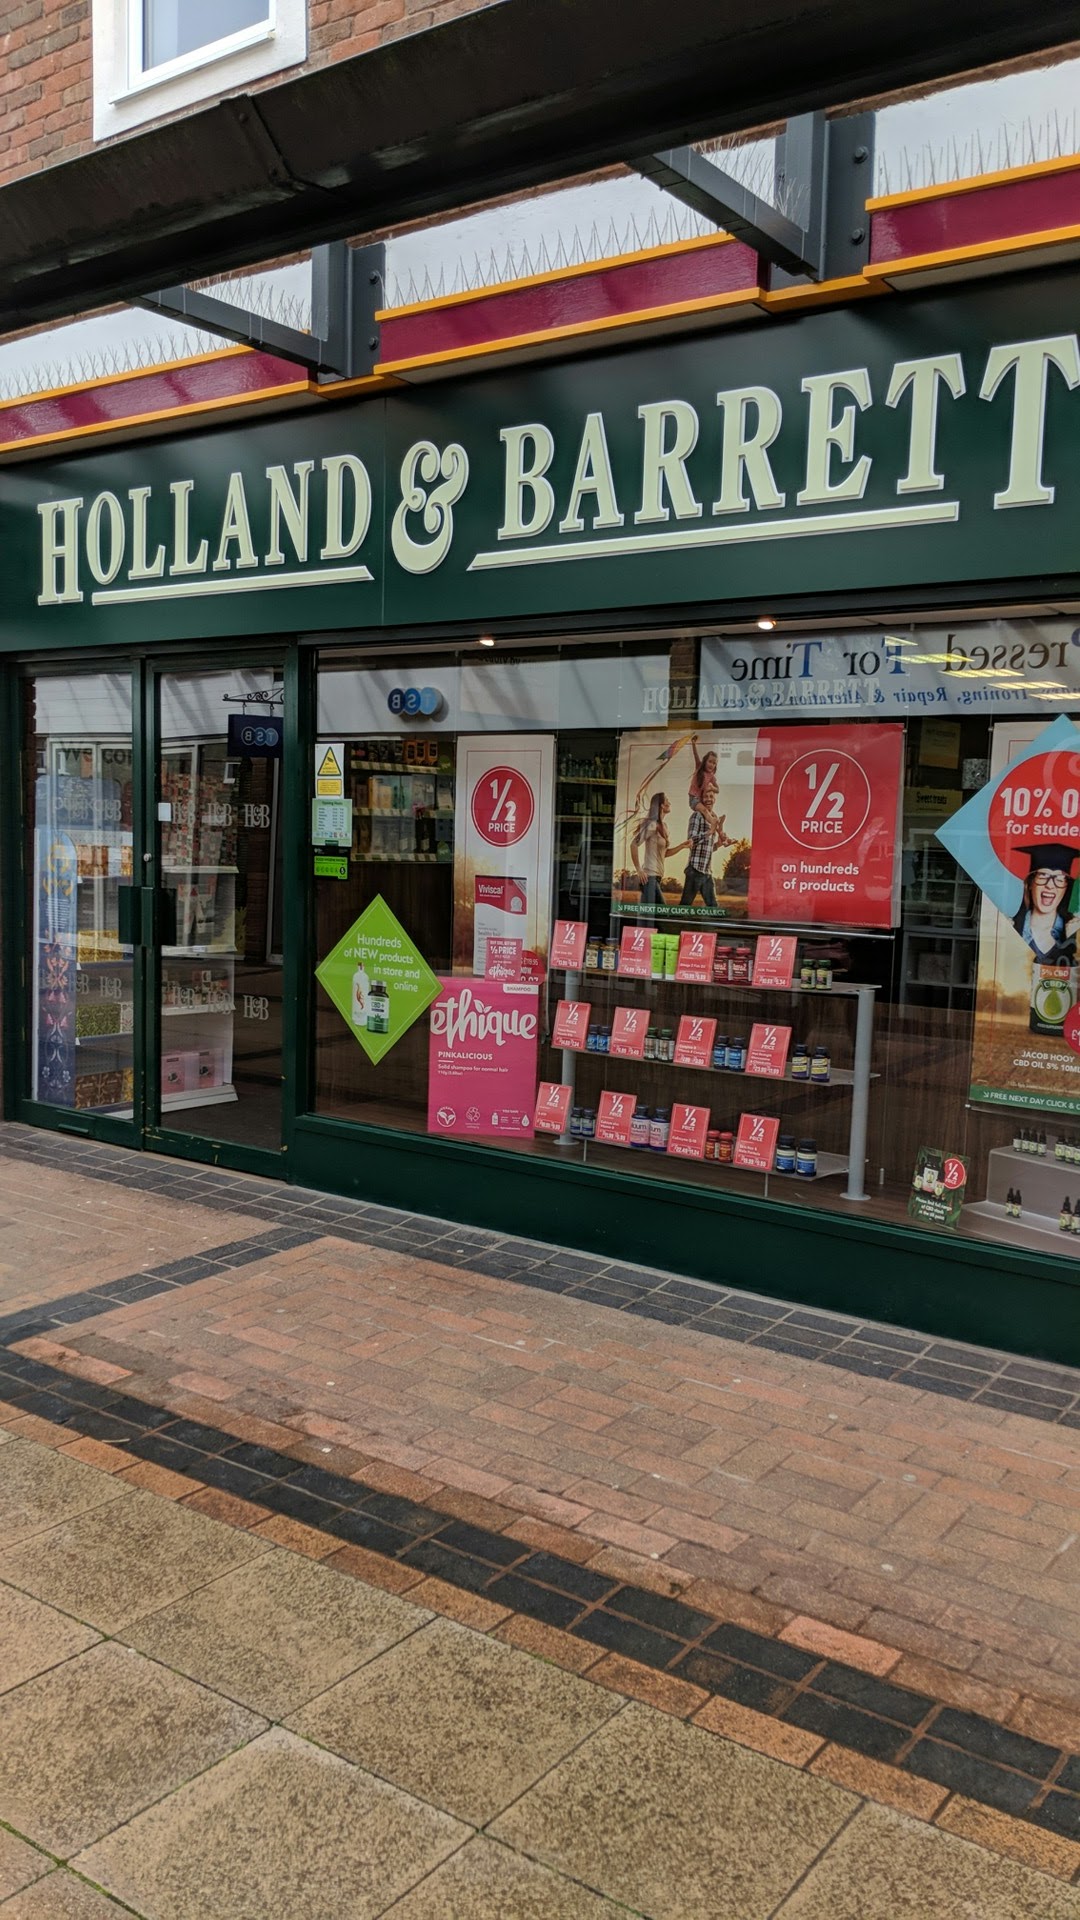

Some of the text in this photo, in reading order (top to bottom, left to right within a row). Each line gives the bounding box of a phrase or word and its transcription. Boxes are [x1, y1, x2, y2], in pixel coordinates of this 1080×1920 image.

[37, 334, 1080, 606] HOLLAND & BARRETT
[643, 683, 741, 713] HOLLAND
[1000, 787, 1052, 818] 10%
[488, 823, 516, 833] PRICE
[801, 820, 843, 834] PRICE
[1006, 820, 1080, 837] for stude
[781, 861, 859, 876] on hundreds
[478, 884, 503, 894] Viviscal
[783, 879, 855, 893] of products
[671, 907, 689, 915] CLICK
[696, 908, 726, 916] COLLECT
[357, 934, 402, 948] Hundreds
[344, 948, 413, 964] of NEW products
[498, 947, 516, 955] PRICE
[374, 964, 420, 979] in store and
[394, 981, 418, 993] online
[430, 989, 537, 1049] ethique
[438, 1051, 493, 1060] PINKALICIOUS
[1021, 1050, 1075, 1063] JACOB HOOY
[1013, 1058, 1030, 1067] CBD
[1031, 1061, 1045, 1069] OIL
[1046, 1062, 1059, 1071] 5%
[990, 1091, 1007, 1100] FREE
[1009, 1094, 1028, 1103] NEXT
[1029, 1097, 1045, 1105] DAY
[1046, 1099, 1068, 1108] CLICK
